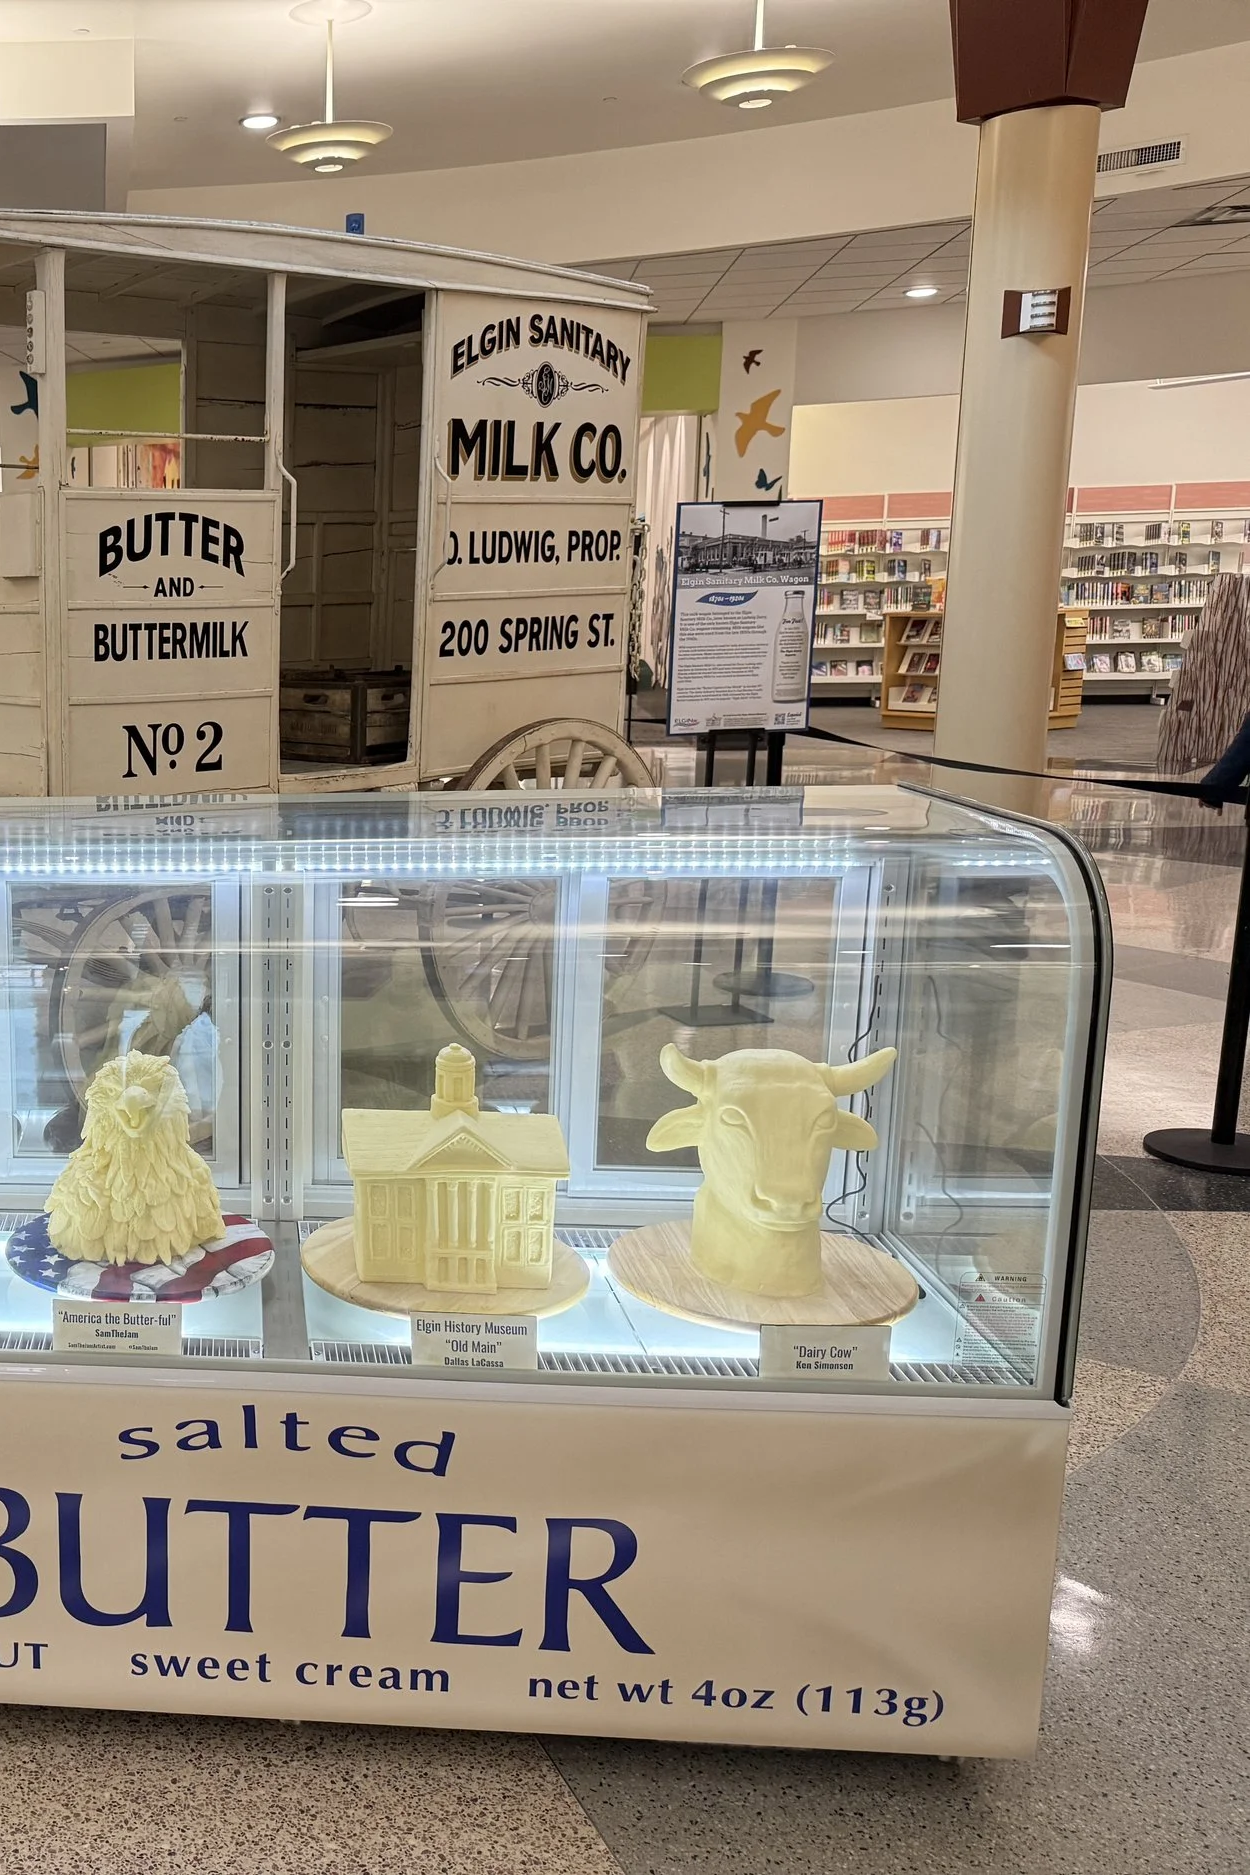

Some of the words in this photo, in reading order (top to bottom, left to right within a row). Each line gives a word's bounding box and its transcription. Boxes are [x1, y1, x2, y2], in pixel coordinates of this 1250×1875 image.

[450, 316, 521, 380] ELGIN
[528, 313, 631, 386] SANITARY
[447, 418, 562, 482] MILK
[569, 422, 627, 484] CO.
[99, 512, 245, 577] BUTTER
[469, 530, 560, 565] LUDWIG,
[567, 529, 621, 562] PROP.
[153, 577, 194, 597] AND
[681, 578, 704, 587] Elgin
[705, 577, 742, 586] Sanitary
[744, 575, 764, 584] Milk
[766, 575, 779, 583] Co.
[780, 575, 809, 584] Wagon
[94, 621, 249, 662] BUTTERMILK
[439, 619, 489, 657] 200
[498, 614, 579, 654] SPRING
[587, 613, 615, 649] ST.
[195, 721, 223, 772] 2
[95, 1329, 139, 1339] SamTheJam
[105, 1312, 120, 1325] the
[416, 1319, 441, 1334] Elgin
[444, 1320, 481, 1335] History
[485, 1322, 527, 1335] Museum
[444, 1357, 469, 1366] Dallas
[471, 1358, 504, 1368] LaCassa
[796, 1361, 811, 1369] Ken
[814, 1361, 853, 1370] Simonsen
[119, 1404, 456, 1477] salted
[130, 1652, 272, 1685] sweet
[295, 1662, 451, 1694] cream
[528, 1675, 599, 1701] net
[617, 1678, 674, 1705] wt
[691, 1680, 774, 1710] 4oz
[796, 1683, 945, 1727] (113g)
